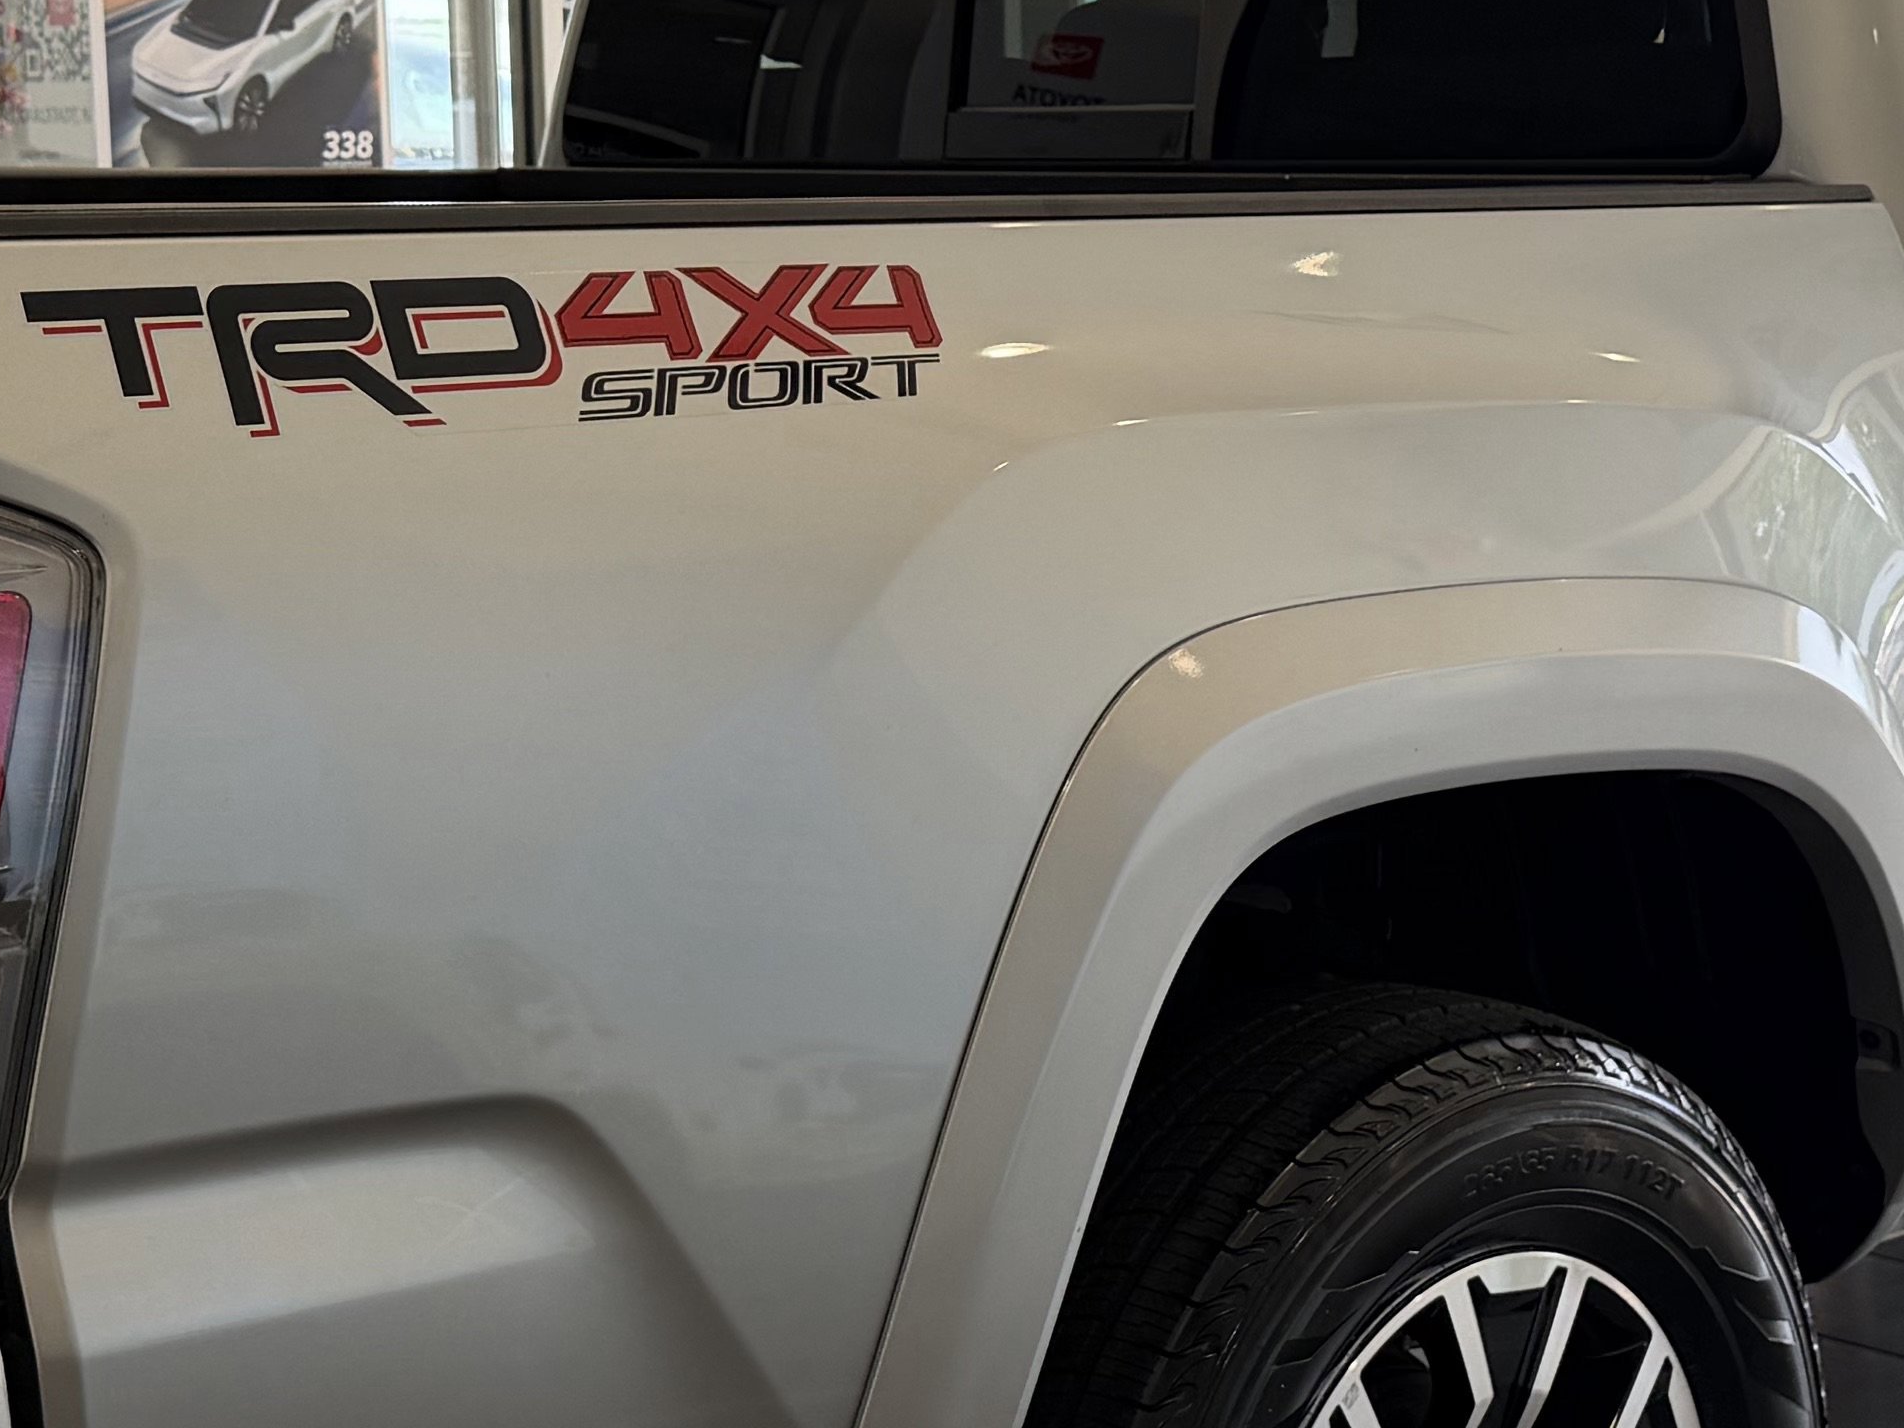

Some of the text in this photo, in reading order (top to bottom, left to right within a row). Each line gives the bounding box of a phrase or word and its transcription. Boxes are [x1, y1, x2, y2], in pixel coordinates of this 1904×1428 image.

[322, 130, 374, 160] 338
[20, 276, 562, 439] TRD
[578, 353, 940, 422] SPORT
